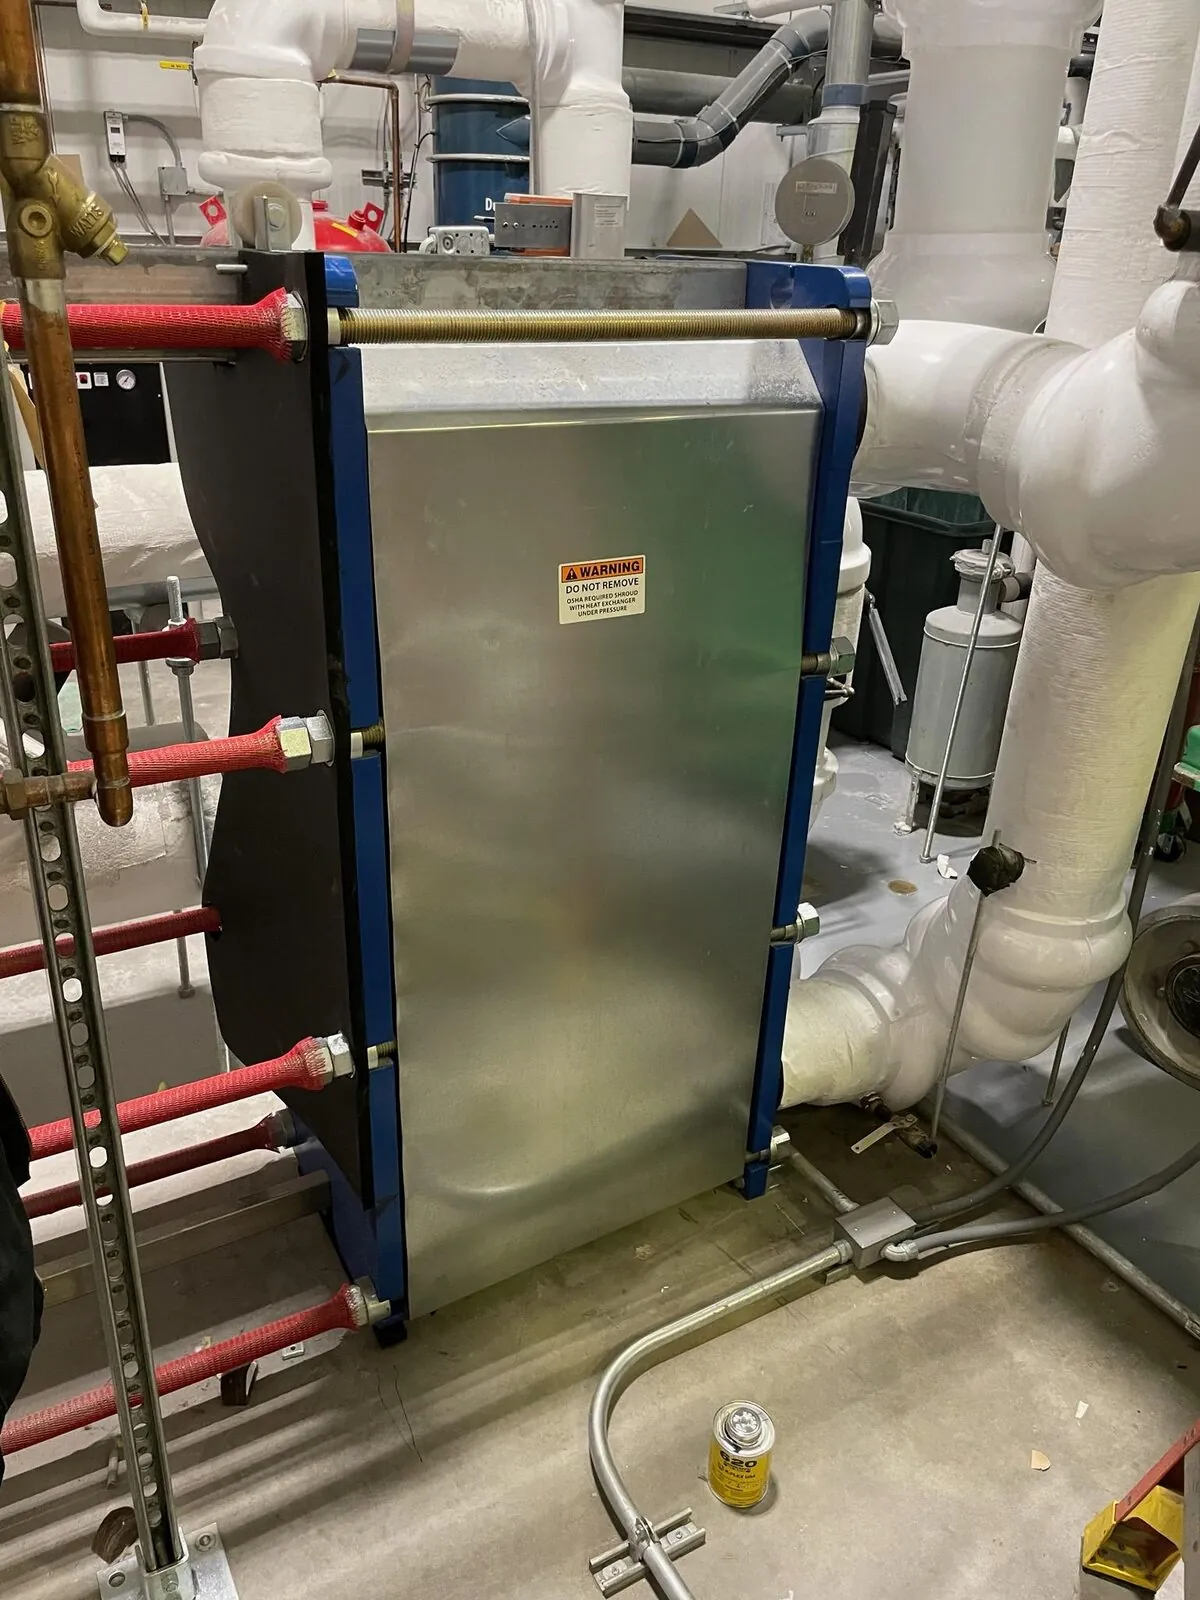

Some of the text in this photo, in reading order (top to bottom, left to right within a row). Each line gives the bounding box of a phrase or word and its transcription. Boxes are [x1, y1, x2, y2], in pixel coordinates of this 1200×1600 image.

[70, 203, 105, 239] WATTS
[580, 561, 640, 577] WARNING
[566, 578, 639, 594] DO NOT REMOVE
[584, 593, 613, 602] REQUIRED
[614, 590, 639, 598] SHROUD
[569, 598, 636, 611] WITH HEAT EXCHANGER
[577, 605, 627, 617] UNDER PRESSURE
[720, 1450, 758, 1468] 620
